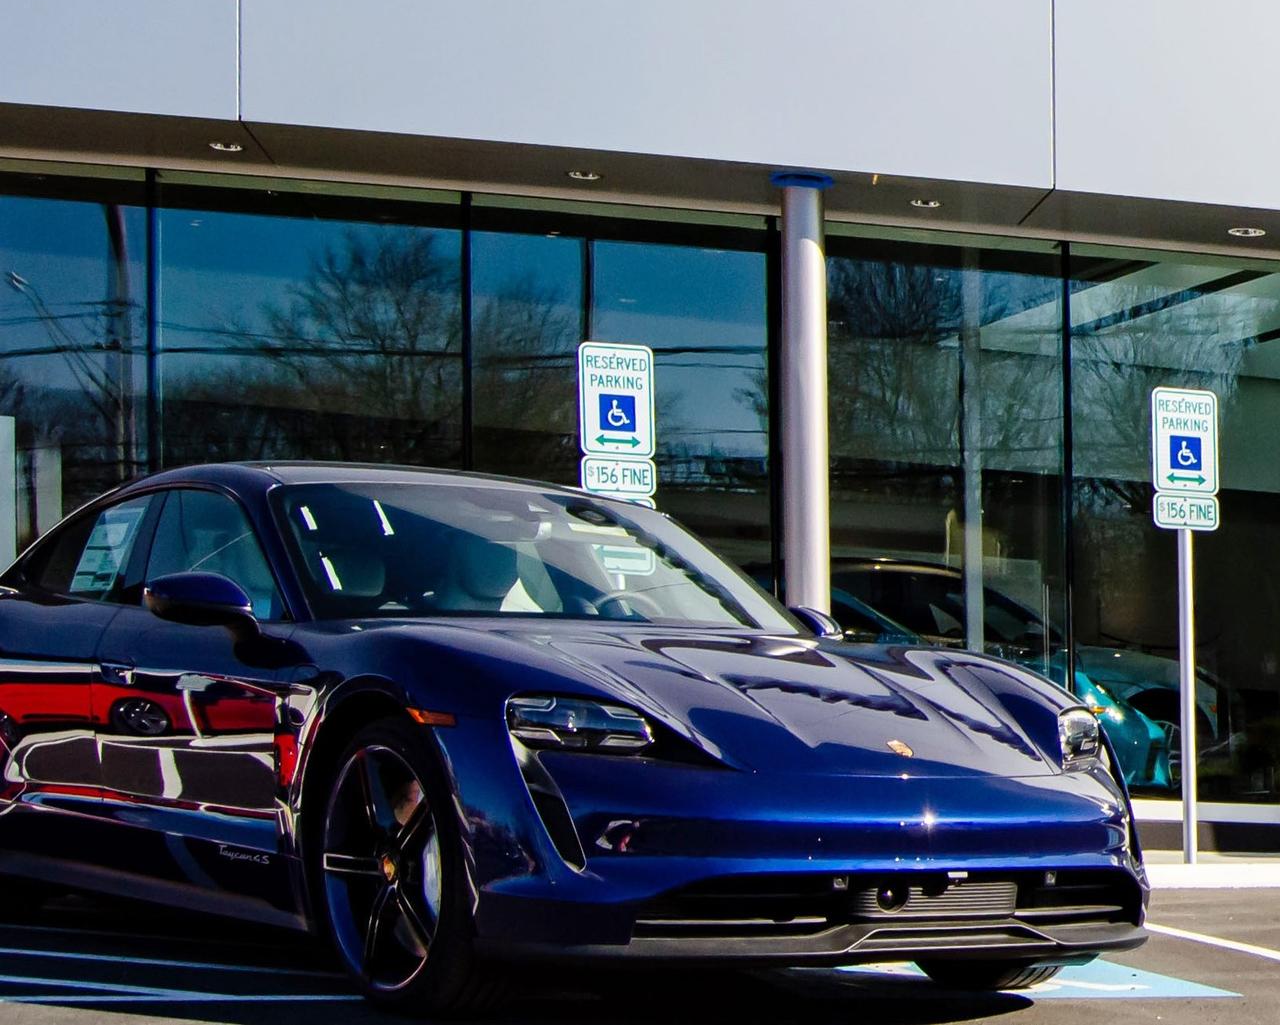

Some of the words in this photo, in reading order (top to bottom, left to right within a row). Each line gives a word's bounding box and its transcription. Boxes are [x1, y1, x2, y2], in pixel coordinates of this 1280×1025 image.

[585, 354, 647, 372] RESERVED
[590, 374, 643, 390] PARKING
[1158, 399, 1211, 415] RESERVED
[1162, 417, 1209, 433] PARKING
[588, 466, 619, 484] $156
[622, 467, 650, 486] FINE
[1159, 502, 1186, 519] $156
[1189, 504, 1214, 521] FINE
